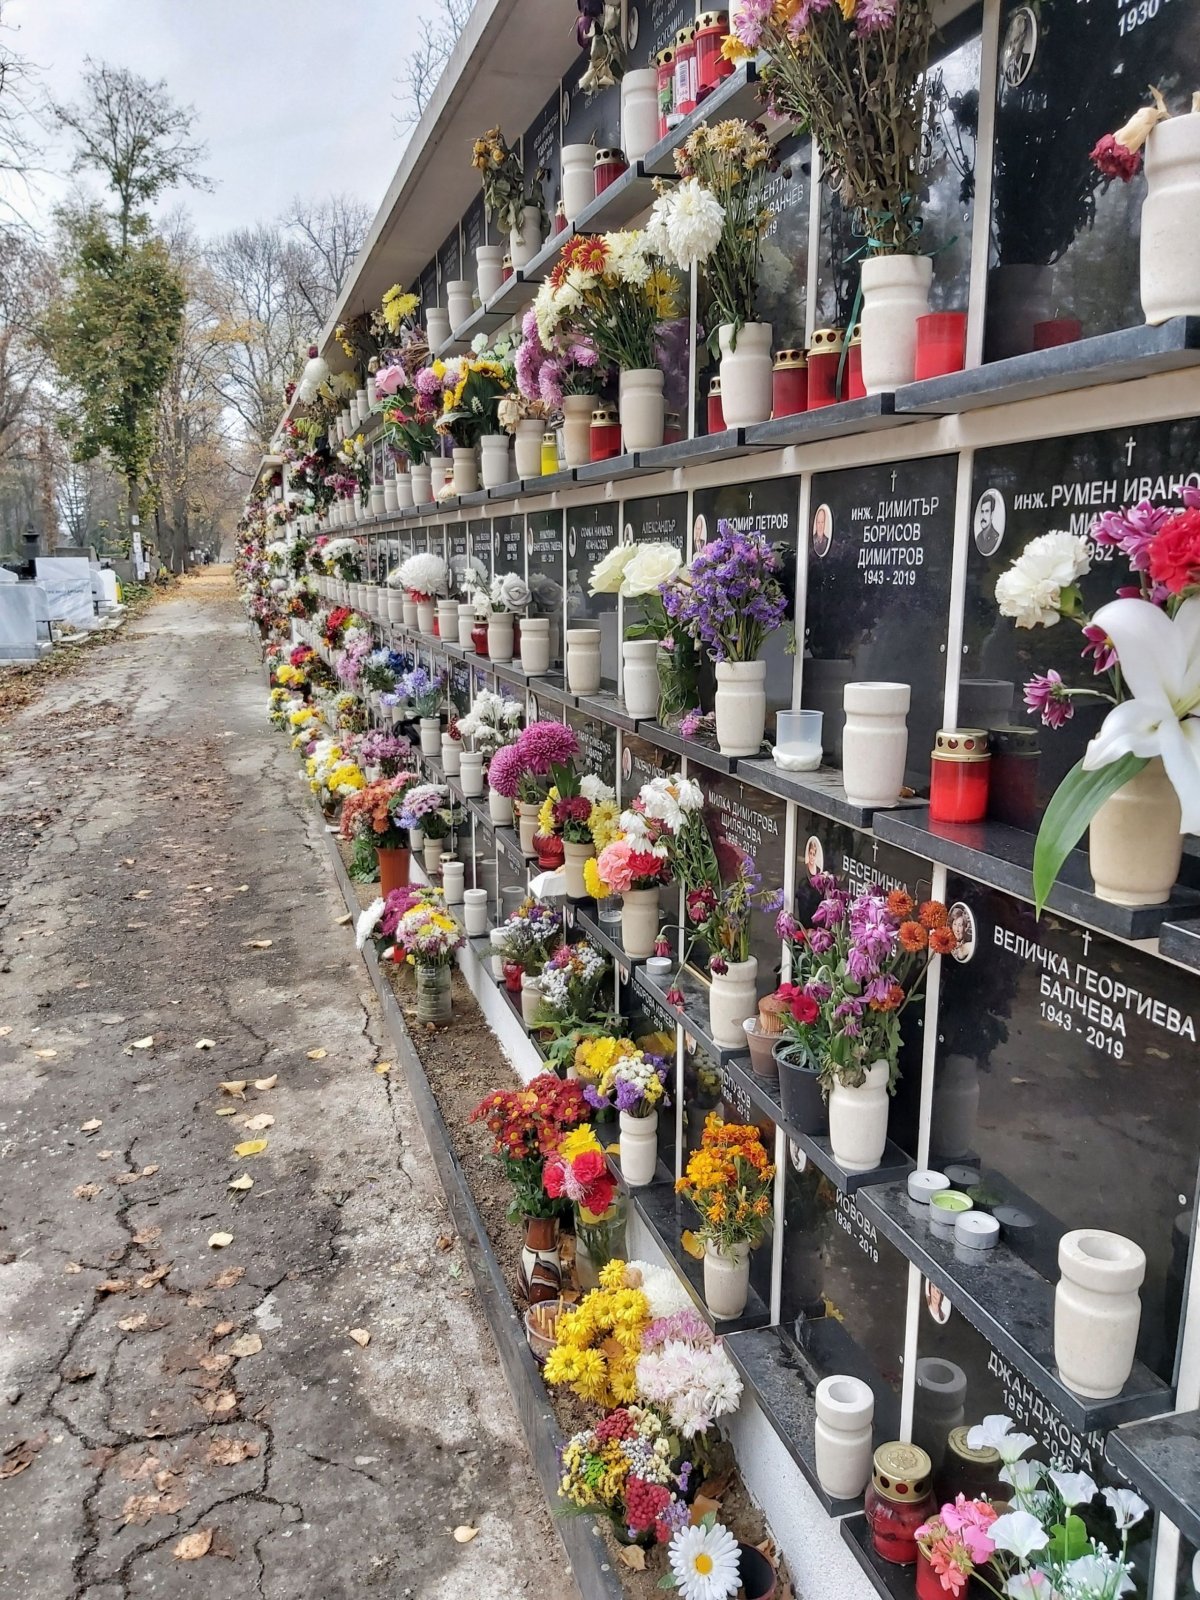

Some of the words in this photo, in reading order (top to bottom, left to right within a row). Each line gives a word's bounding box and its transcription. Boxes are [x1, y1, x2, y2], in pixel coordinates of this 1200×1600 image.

[1051, 480, 1117, 507] РУМЕН
[756, 513, 789, 530] ПЕТРОВ
[877, 496, 939, 522] ДИМИТЪР
[863, 523, 921, 542] БОРИСОВ
[857, 547, 924, 569] ДИМИТРОВ
[1086, 543, 1114, 561] 952
[863, 570, 884, 584] 1943
[892, 570, 916, 586] 2019
[732, 801, 778, 836] ДИМИТРОВА
[842, 855, 908, 894] ВЕСЕЛИНКА
[993, 925, 1070, 980] ВЕЛИЧКА
[1075, 964, 1197, 1042] ГЕОРГИЕВА
[1040, 974, 1127, 1037] БАЛЧЕВА
[1040, 1001, 1072, 1031] 1943
[1086, 1026, 1124, 1059] 2019
[859, 1234, 879, 1263] 2019
[987, 1350, 1093, 1472] ДЖАНДЖОВА
[1002, 1389, 1030, 1427] 1951
[1042, 1432, 1074, 1473] 2019
